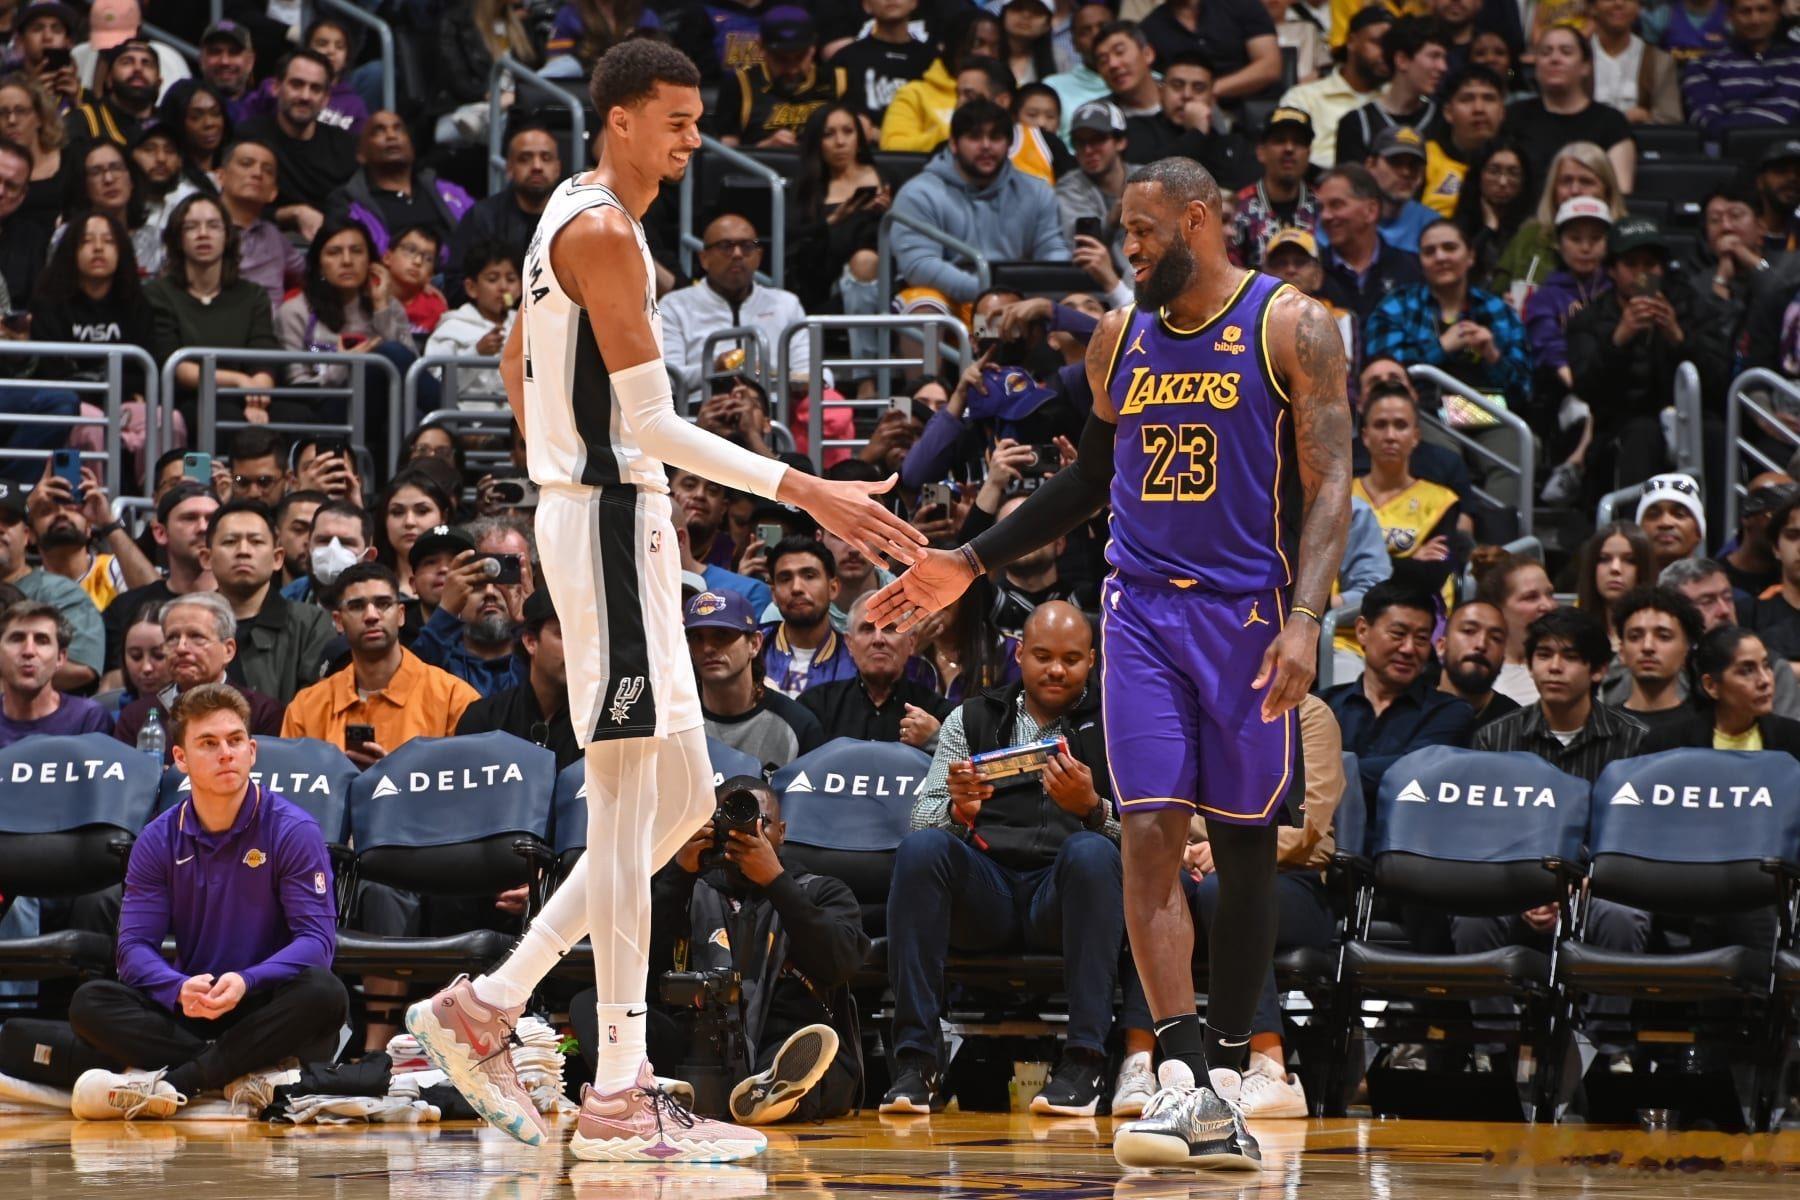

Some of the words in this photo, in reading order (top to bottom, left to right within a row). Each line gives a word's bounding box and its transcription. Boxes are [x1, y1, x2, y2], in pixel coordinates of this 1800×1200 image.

[1214, 342, 1246, 355] bibigo
[1119, 367, 1241, 415] LAKERS
[1141, 424, 1217, 502] 23
[11, 760, 125, 783] DELTA
[249, 773, 331, 795] ELTA
[409, 763, 523, 792] DELTA
[1438, 782, 1556, 808] DELTA
[1652, 784, 1773, 808] DELTA
